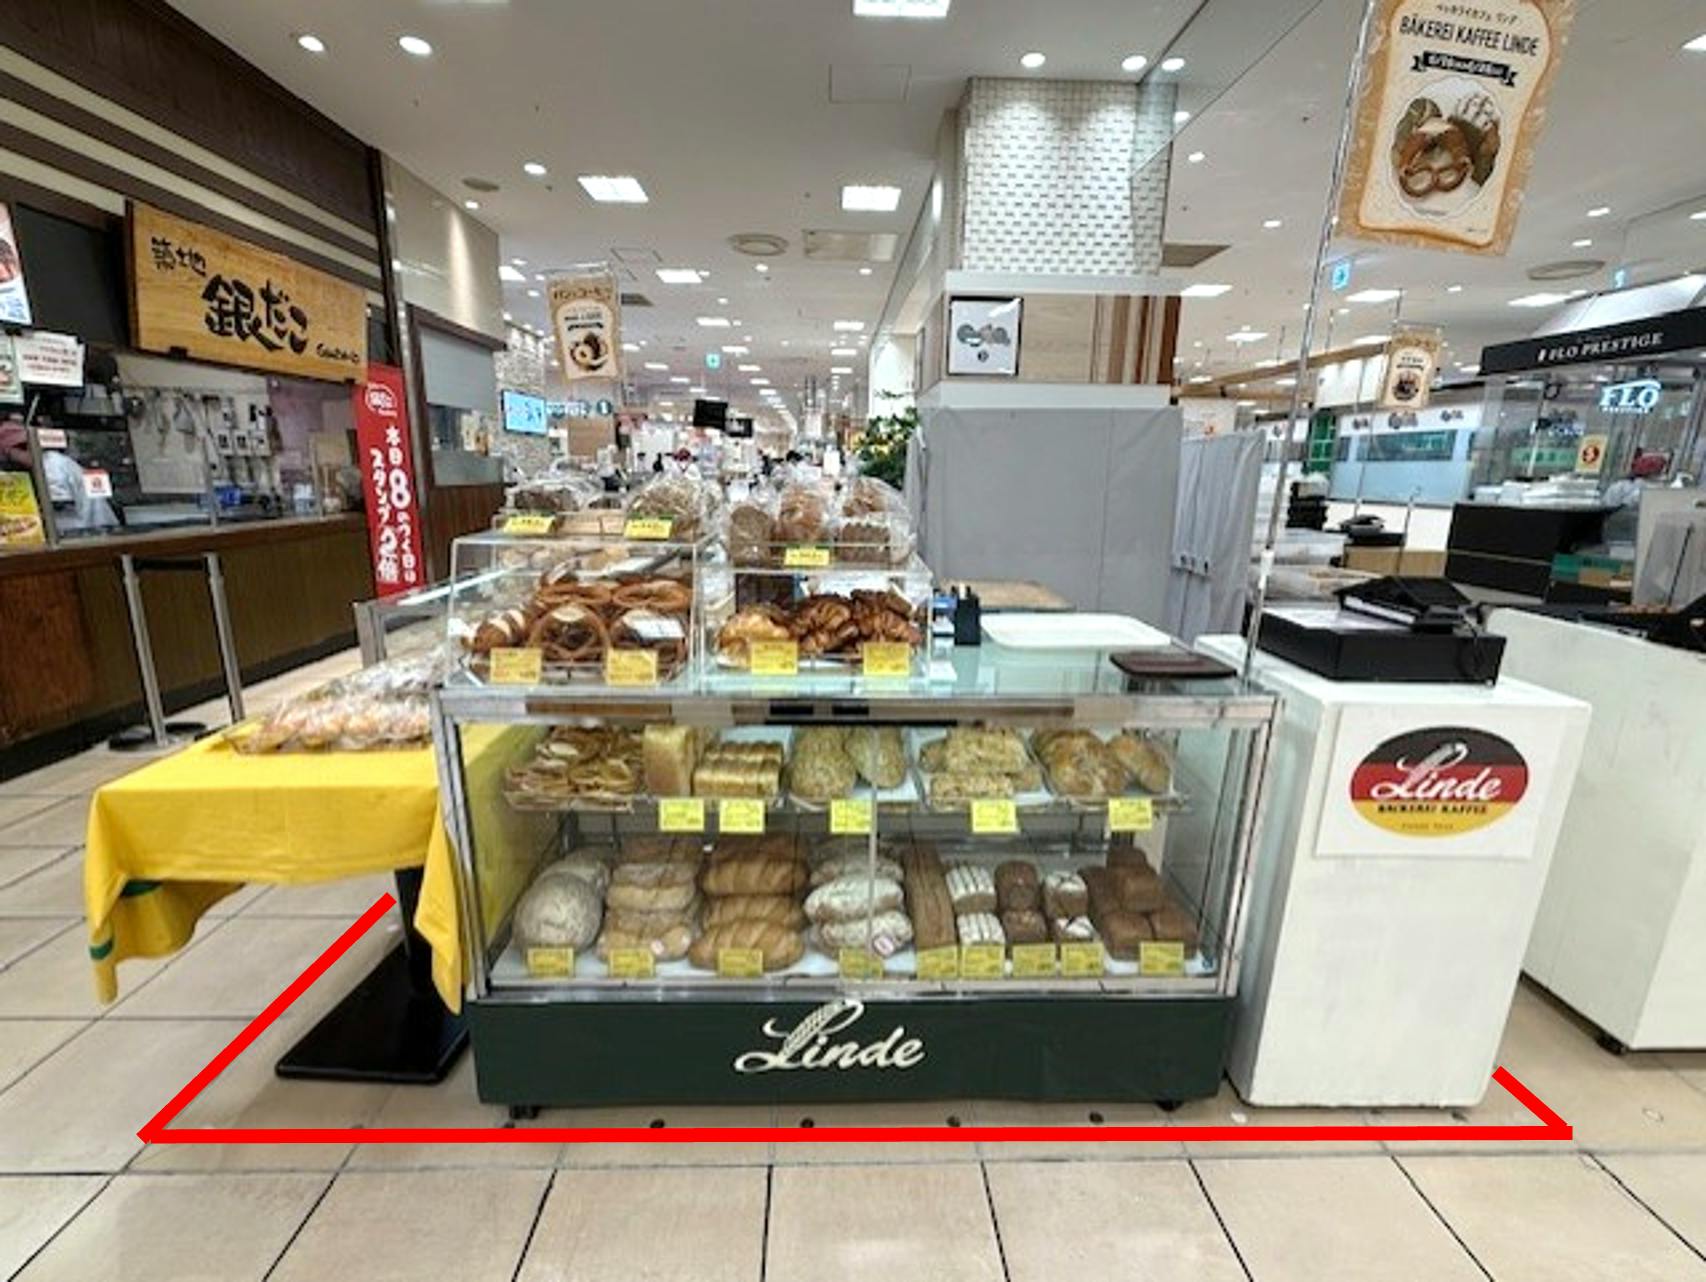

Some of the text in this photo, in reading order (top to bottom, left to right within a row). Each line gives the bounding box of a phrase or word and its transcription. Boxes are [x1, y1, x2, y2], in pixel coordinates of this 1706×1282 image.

[1455, 25, 1502, 50] KAFFEE
[1502, 33, 1539, 57] LINDE
[151, 236, 206, 277] 築地
[202, 273, 308, 355] 銀だこ
[1549, 345, 1579, 361] FLO
[1580, 332, 1665, 356] PRESTIGE
[1599, 379, 1661, 409] FLO
[1369, 742, 1503, 800] Linde
[733, 998, 926, 1072] Linde
